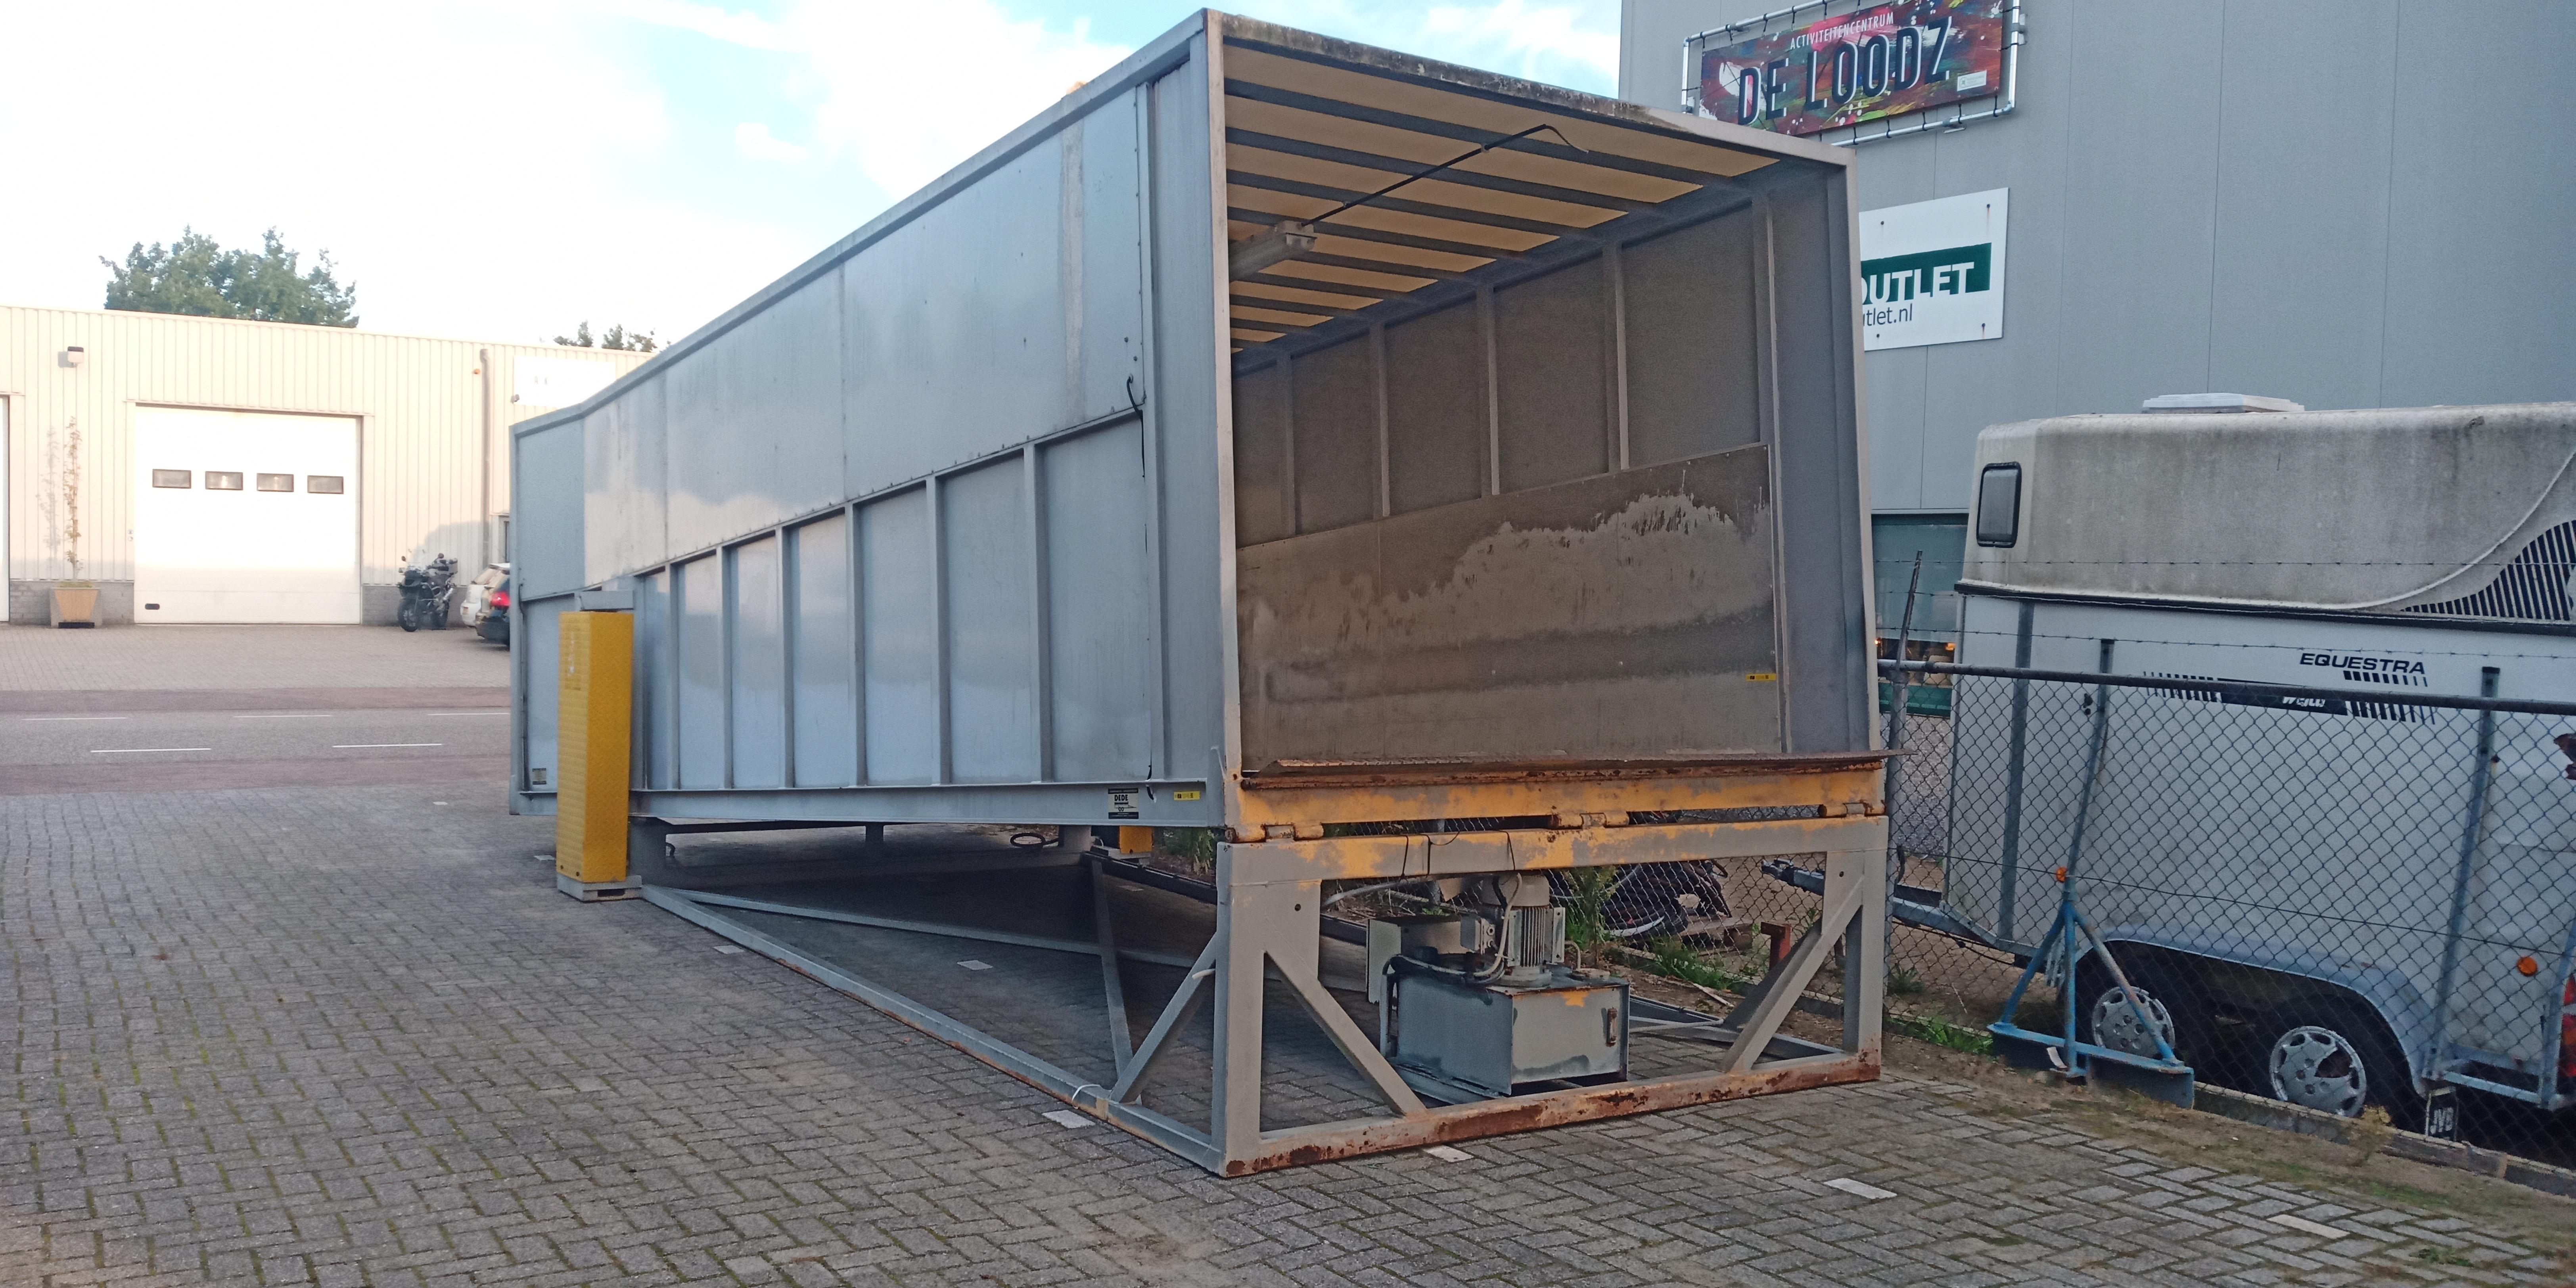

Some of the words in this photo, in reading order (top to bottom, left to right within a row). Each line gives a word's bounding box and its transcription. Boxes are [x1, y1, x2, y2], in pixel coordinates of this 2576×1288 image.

[1790, 12, 1894, 50] ACTIVITEITENCENTRUM
[1738, 58, 1789, 125] DE
[1805, 16, 1951, 111] LOODZ
[2300, 653, 2425, 675] EQUESTRA
